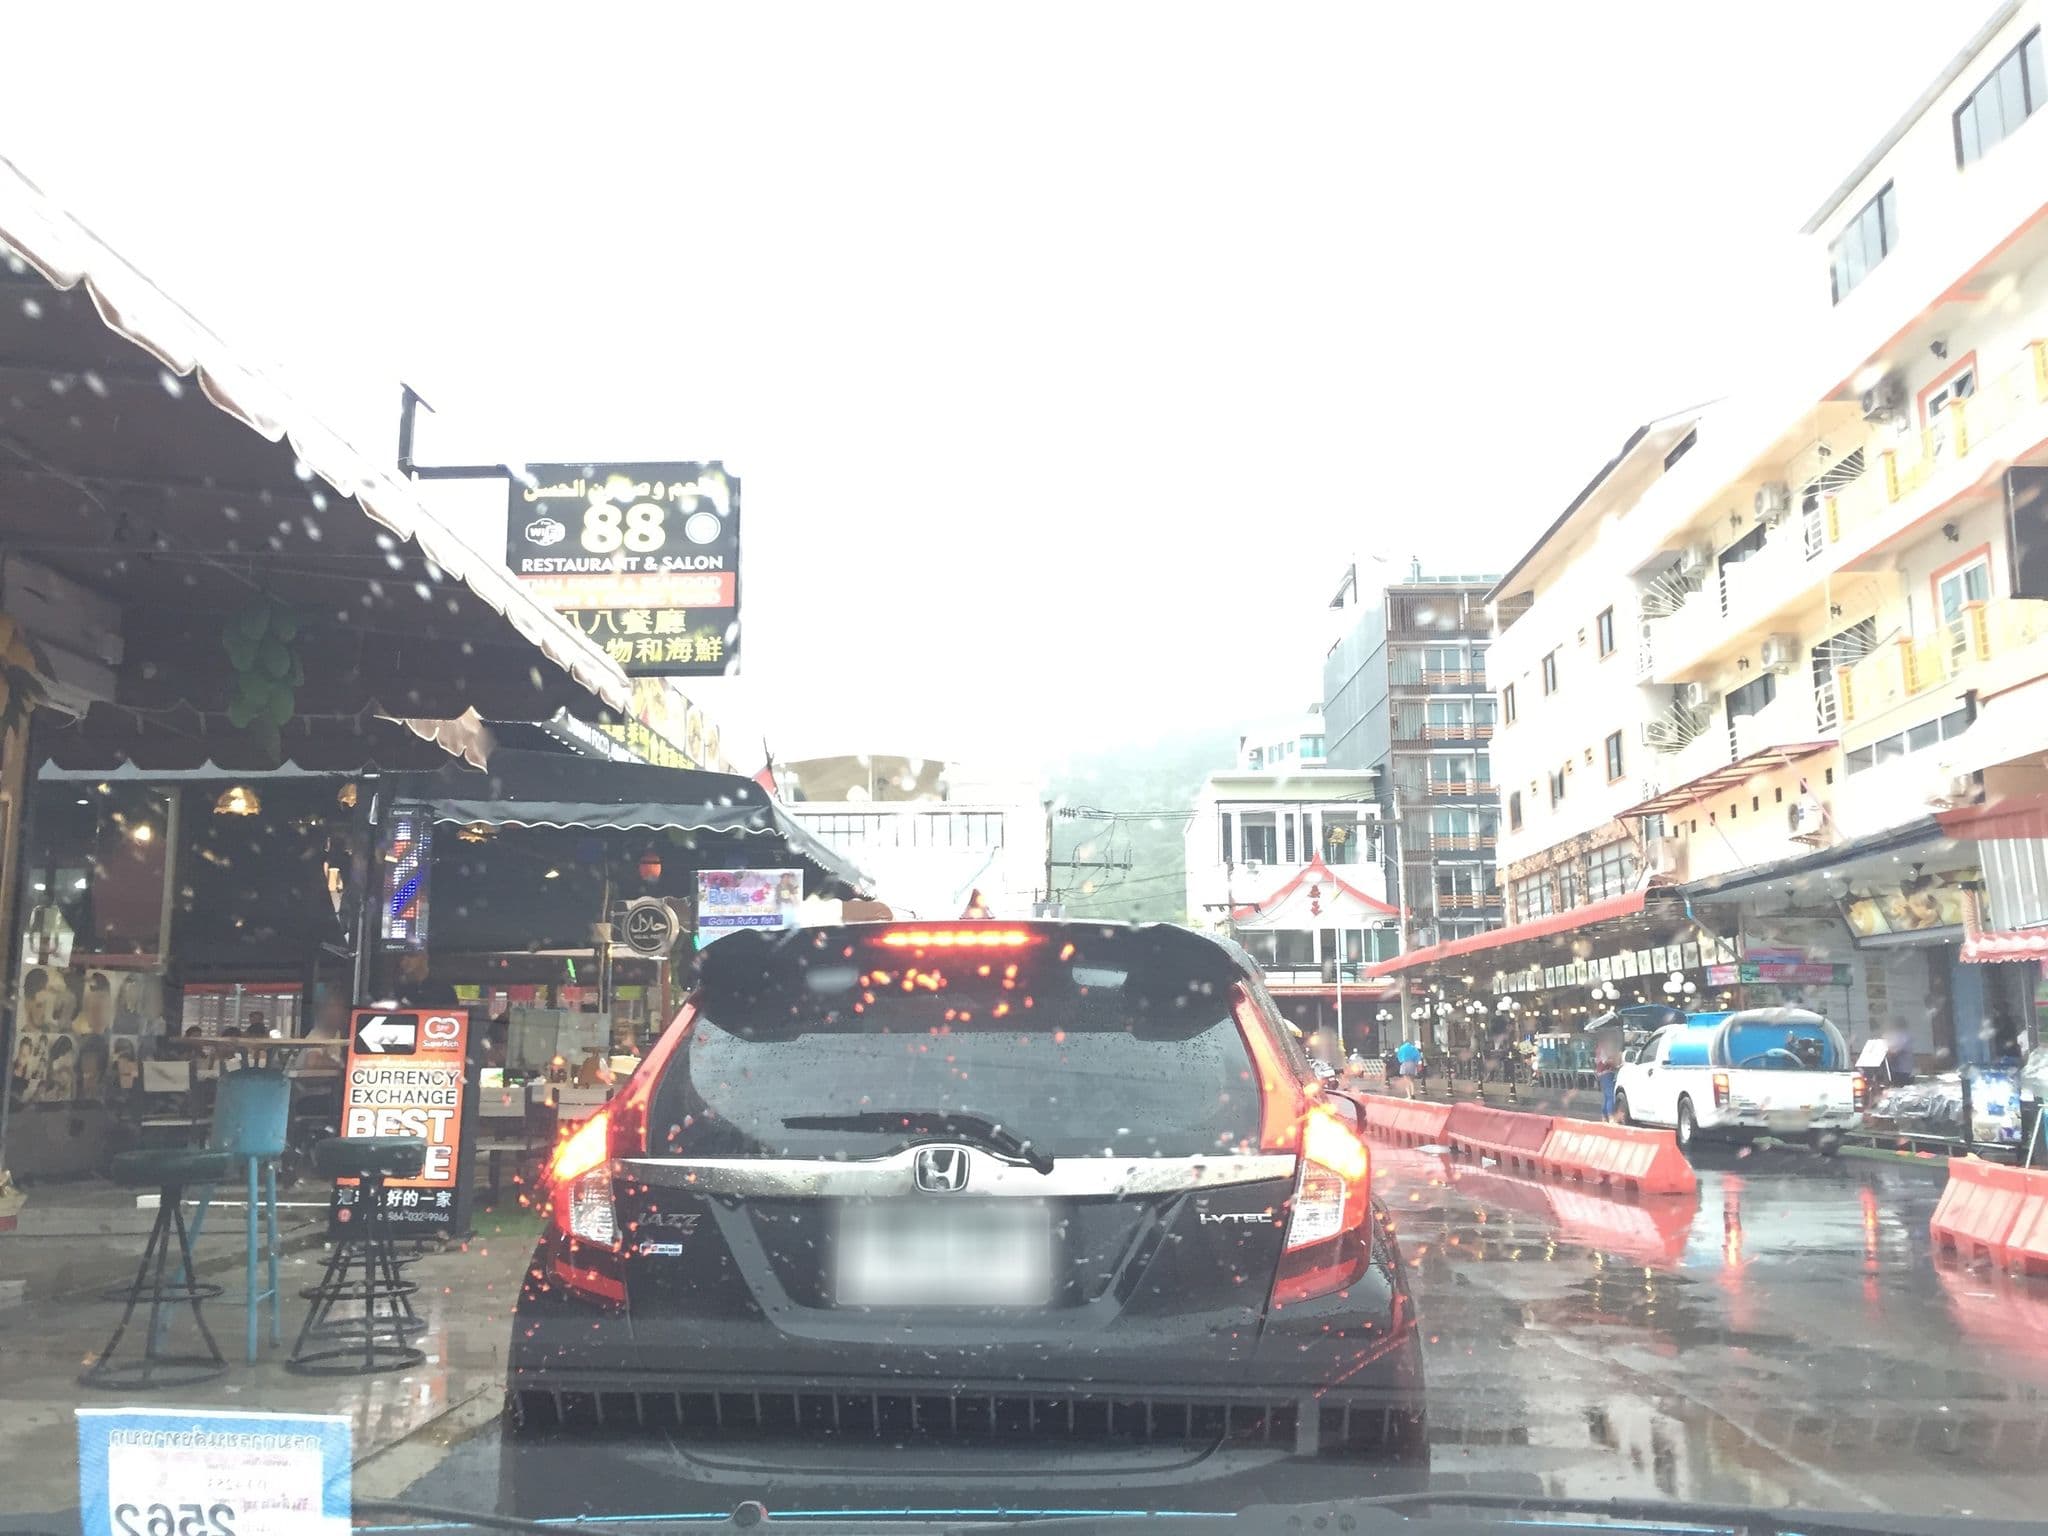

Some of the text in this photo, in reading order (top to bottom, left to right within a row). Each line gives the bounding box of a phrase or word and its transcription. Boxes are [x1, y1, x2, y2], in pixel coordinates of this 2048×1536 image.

[581, 502, 666, 553] 88
[522, 555, 724, 573] RESTAURANT & SALON
[600, 636, 723, 664] 物和海鮮
[630, 912, 667, 932] حلال
[352, 1070, 459, 1086] CURRENCY
[351, 1089, 457, 1105] EXCHANGE
[348, 1108, 454, 1143] BEST
